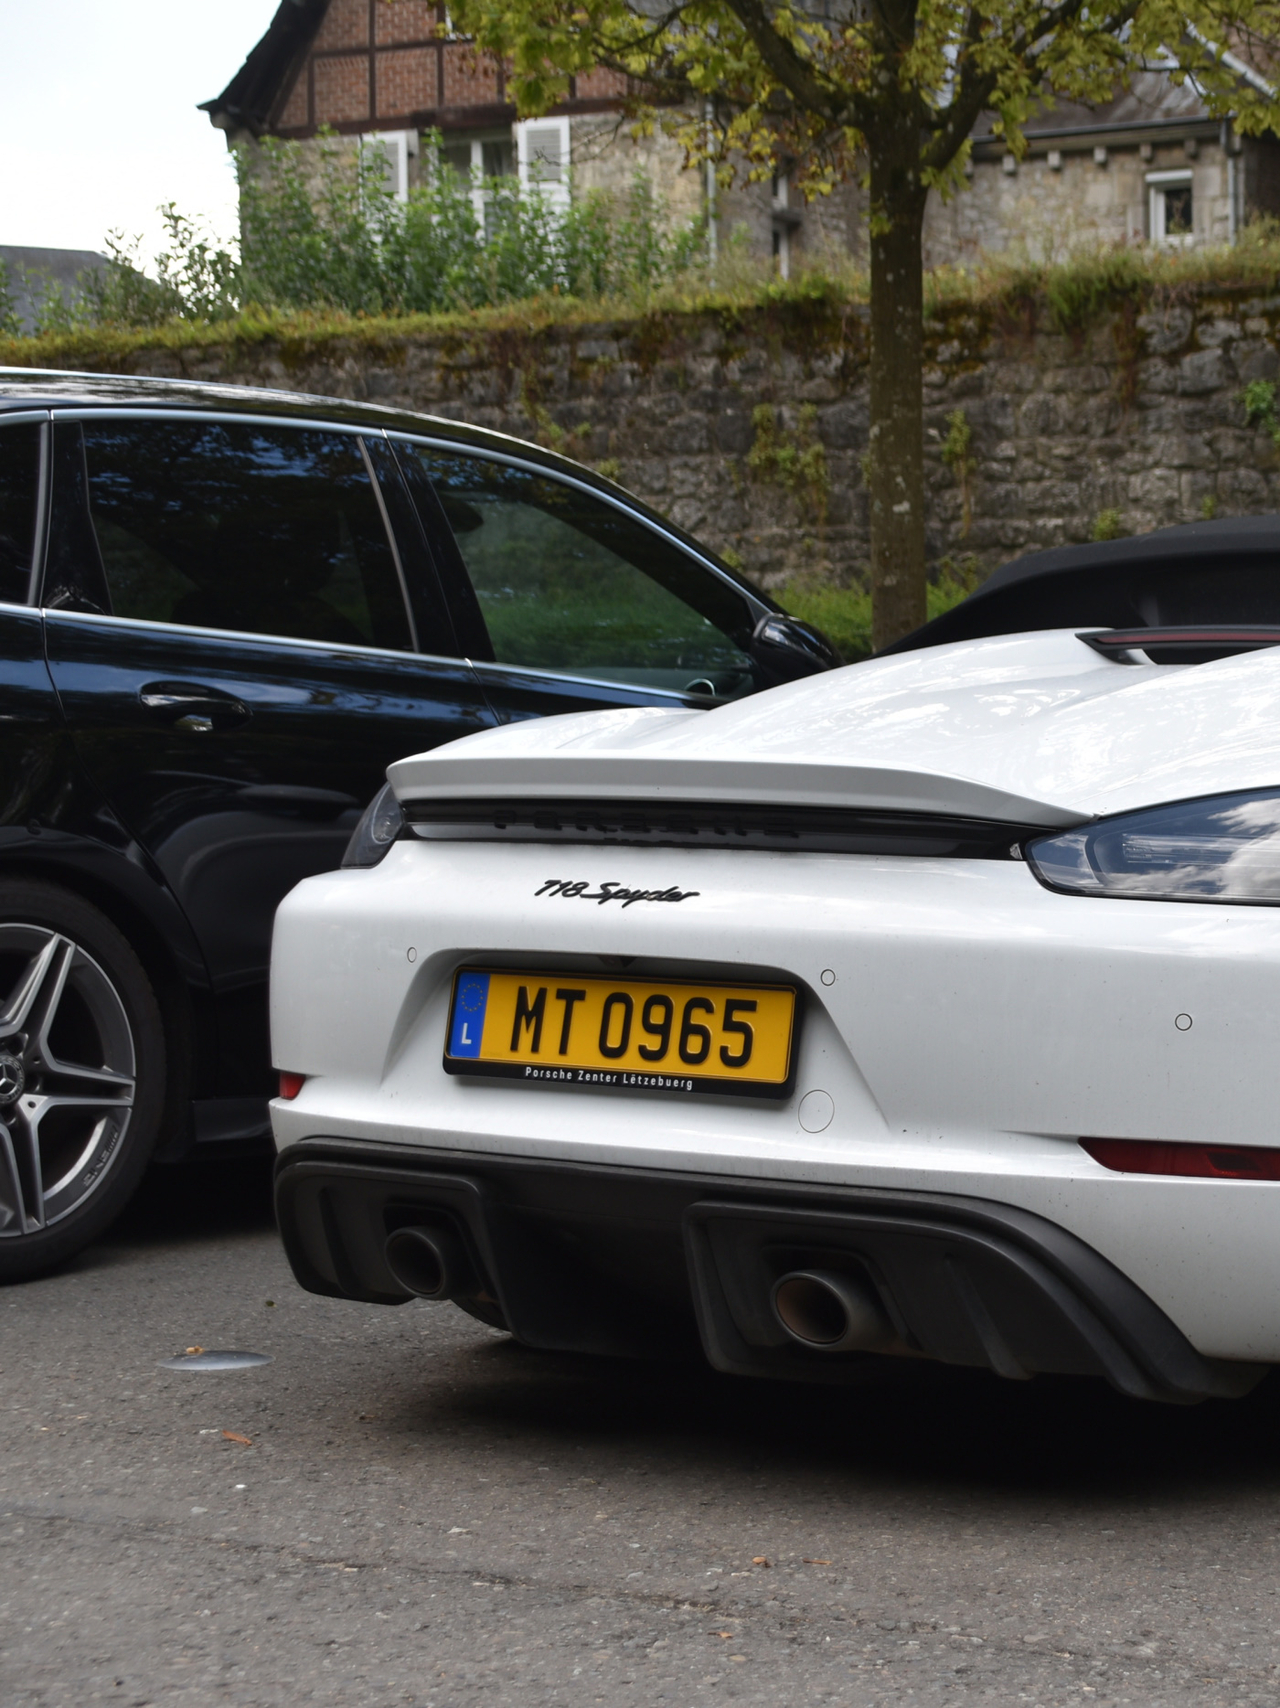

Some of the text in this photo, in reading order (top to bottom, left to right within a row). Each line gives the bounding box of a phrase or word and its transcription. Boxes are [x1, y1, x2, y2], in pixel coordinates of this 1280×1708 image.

[494, 810, 799, 839] PORSCHE
[534, 879, 701, 908] 718 Spyder
[461, 1022, 472, 1045] L
[510, 985, 759, 1067] MT 0965
[525, 1066, 693, 1091] Porsche Zenter Lëtzebuerg
